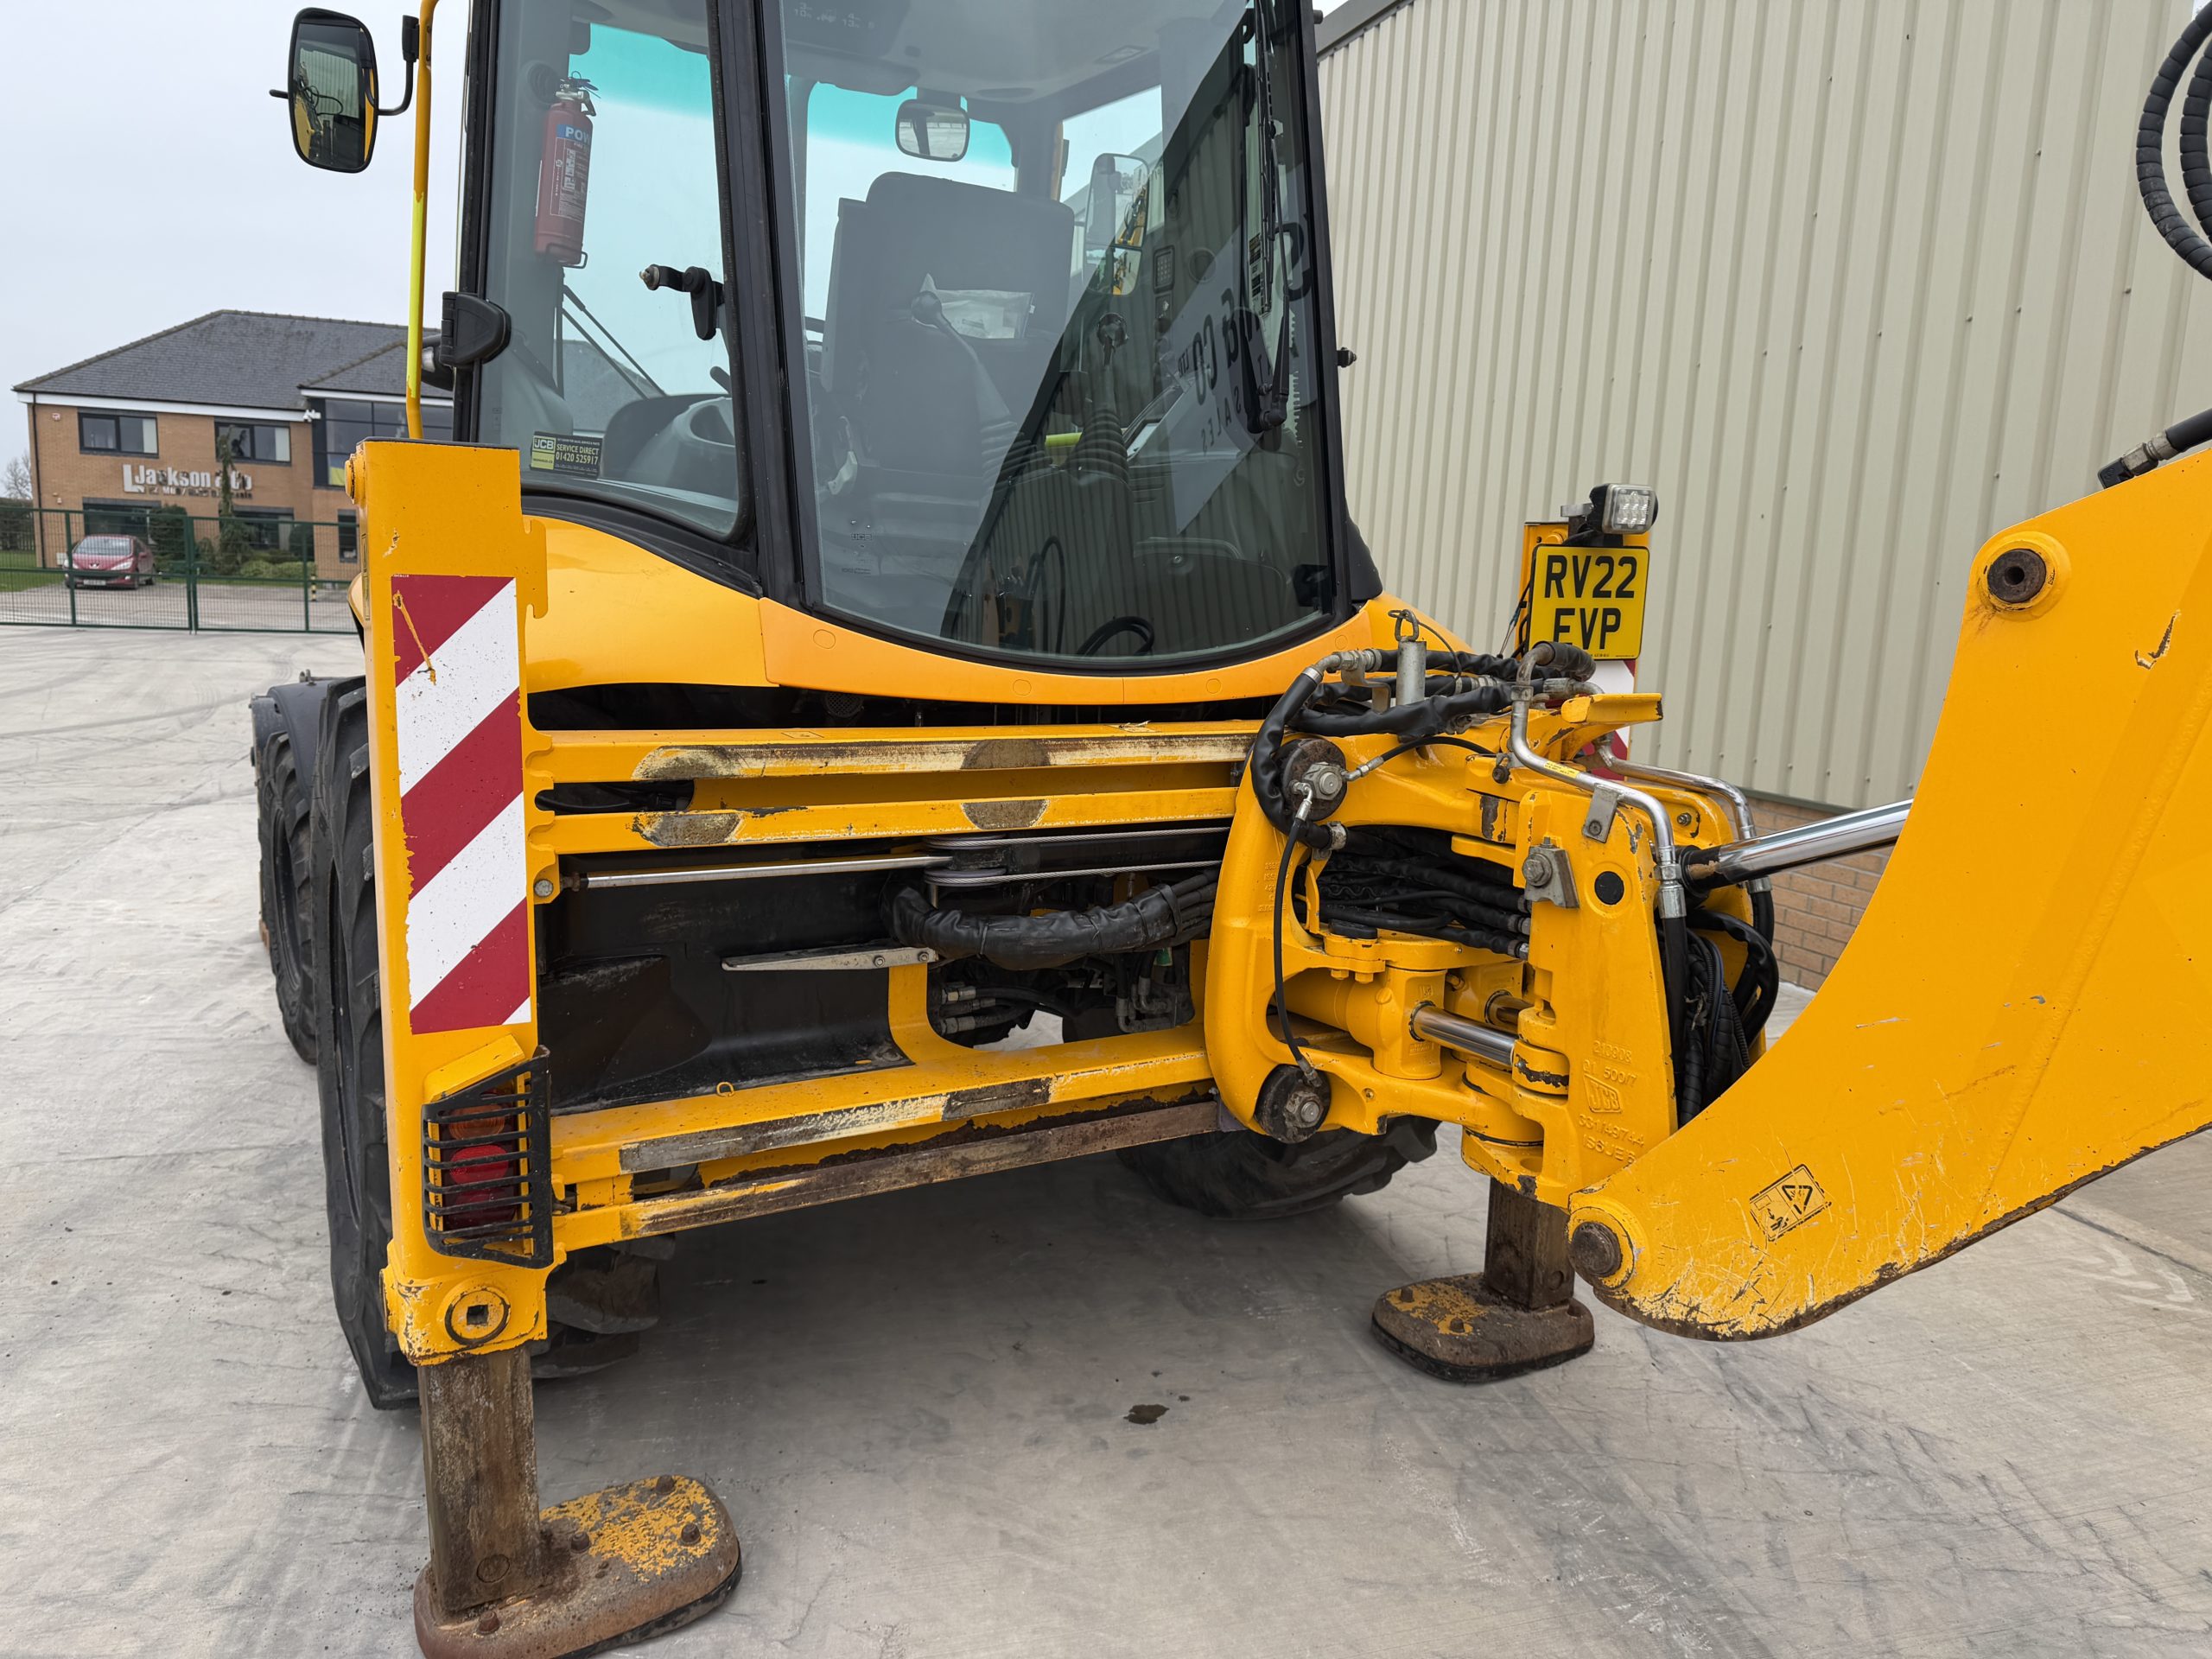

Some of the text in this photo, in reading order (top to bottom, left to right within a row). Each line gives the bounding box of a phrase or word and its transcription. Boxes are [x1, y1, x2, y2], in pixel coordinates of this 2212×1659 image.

[534, 439, 554, 449] JCB
[556, 443, 600, 455] SERVICE DIRECT
[556, 452, 575, 462] 01420
[575, 454, 599, 466] 525917
[1544, 555, 1637, 599] RV22
[1553, 607, 1621, 650] EVP
[1589, 1079, 1619, 1111] JCB
